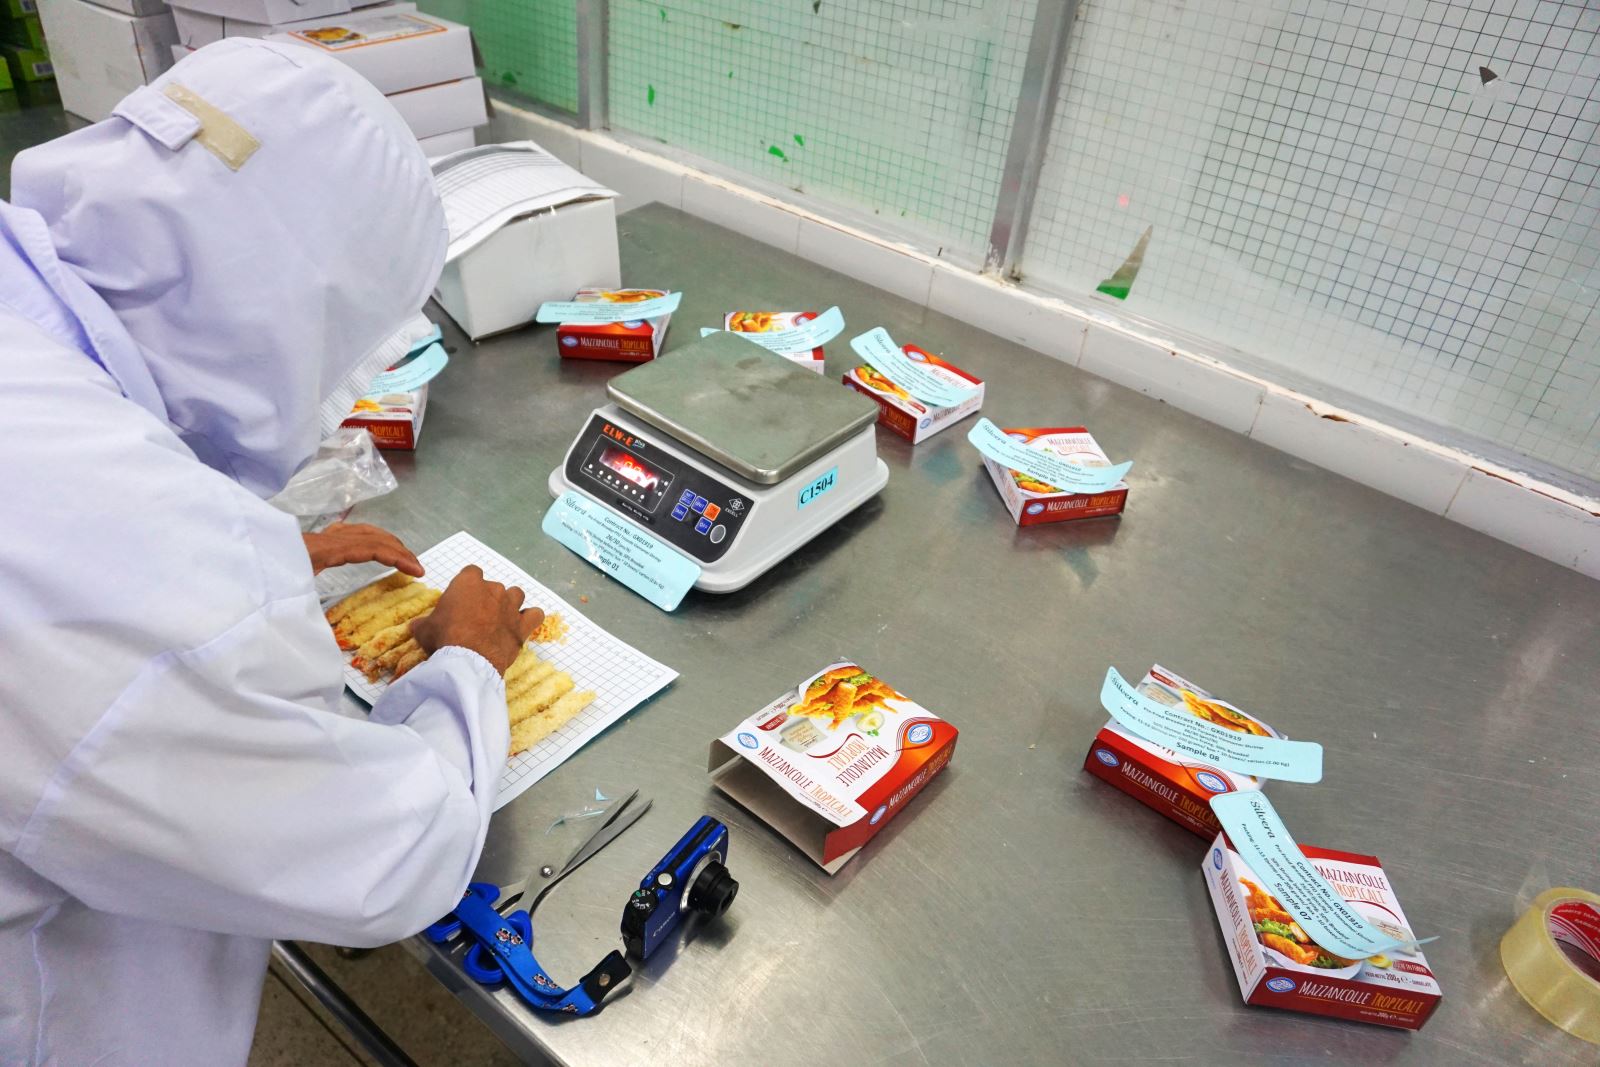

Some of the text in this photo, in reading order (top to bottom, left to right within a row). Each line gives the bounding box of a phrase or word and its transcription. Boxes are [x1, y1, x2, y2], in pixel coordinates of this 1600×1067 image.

[603, 424, 634, 447] ELW-E
[800, 474, 834, 504] C1504
[563, 496, 588, 515] Silvera
[1047, 498, 1088, 512] MAZZANCOLLE
[603, 516, 623, 531] Contract
[605, 533, 620, 545] 26/30
[610, 562, 620, 571] 01
[1111, 677, 1139, 706] Silvera
[1163, 710, 1195, 724] Contract
[836, 744, 890, 787] MAZZANCOLLE
[1175, 741, 1208, 757] Sample
[1208, 753, 1220, 761] 08
[758, 746, 813, 790] MAZZANCOLLE
[810, 784, 853, 818] TROPICALI
[1121, 761, 1179, 803] MAZZANCOLLE
[1250, 800, 1276, 838] Silvera
[1314, 864, 1387, 891] MAZZANCOLLE
[1274, 882, 1312, 921] Sample 07
[1296, 862, 1321, 888] Contract
[1334, 902, 1364, 929] GX01919
[1220, 868, 1243, 930] MAZZANCOLLE
[1238, 924, 1257, 975] TROPICALI
[1298, 980, 1424, 1014] MAZZANCOLLE TROPICALI
